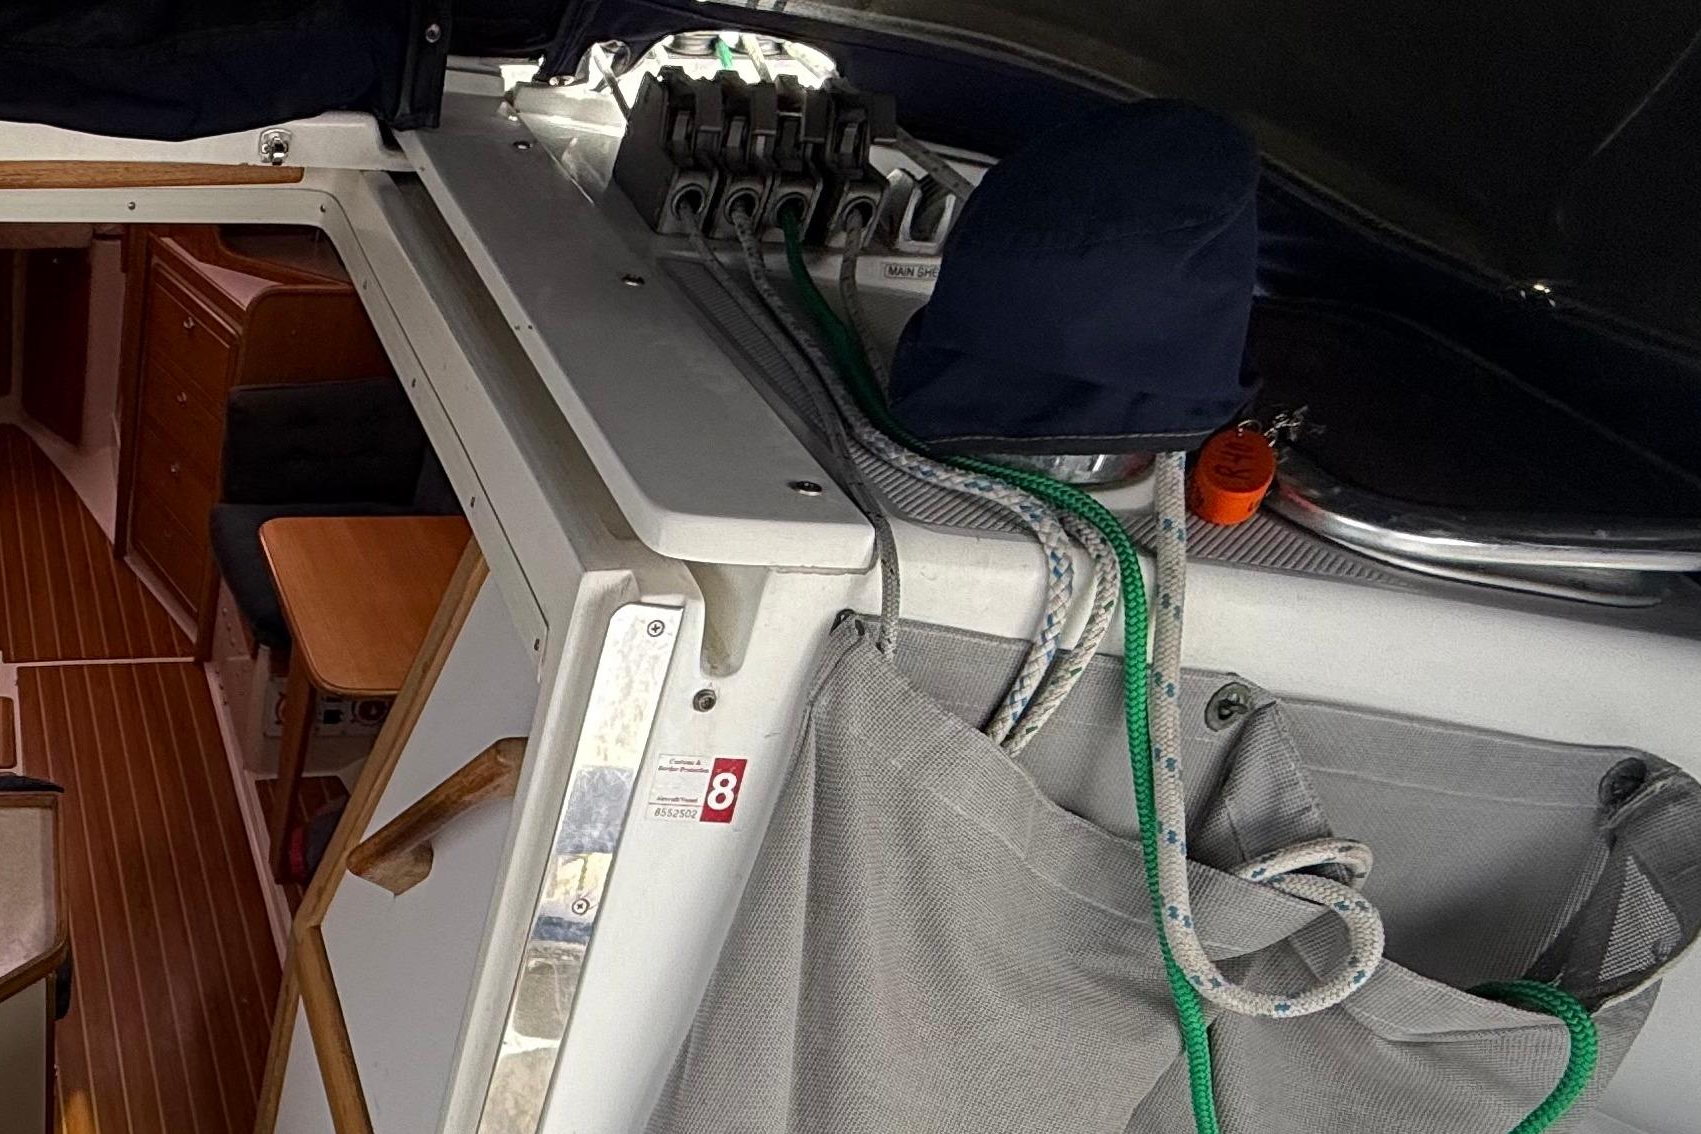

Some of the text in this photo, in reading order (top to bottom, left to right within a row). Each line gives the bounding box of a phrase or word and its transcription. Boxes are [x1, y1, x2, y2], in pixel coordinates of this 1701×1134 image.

[888, 265, 915, 277] MAIN
[707, 772, 737, 811] 8
[654, 808, 698, 819] 8552502
